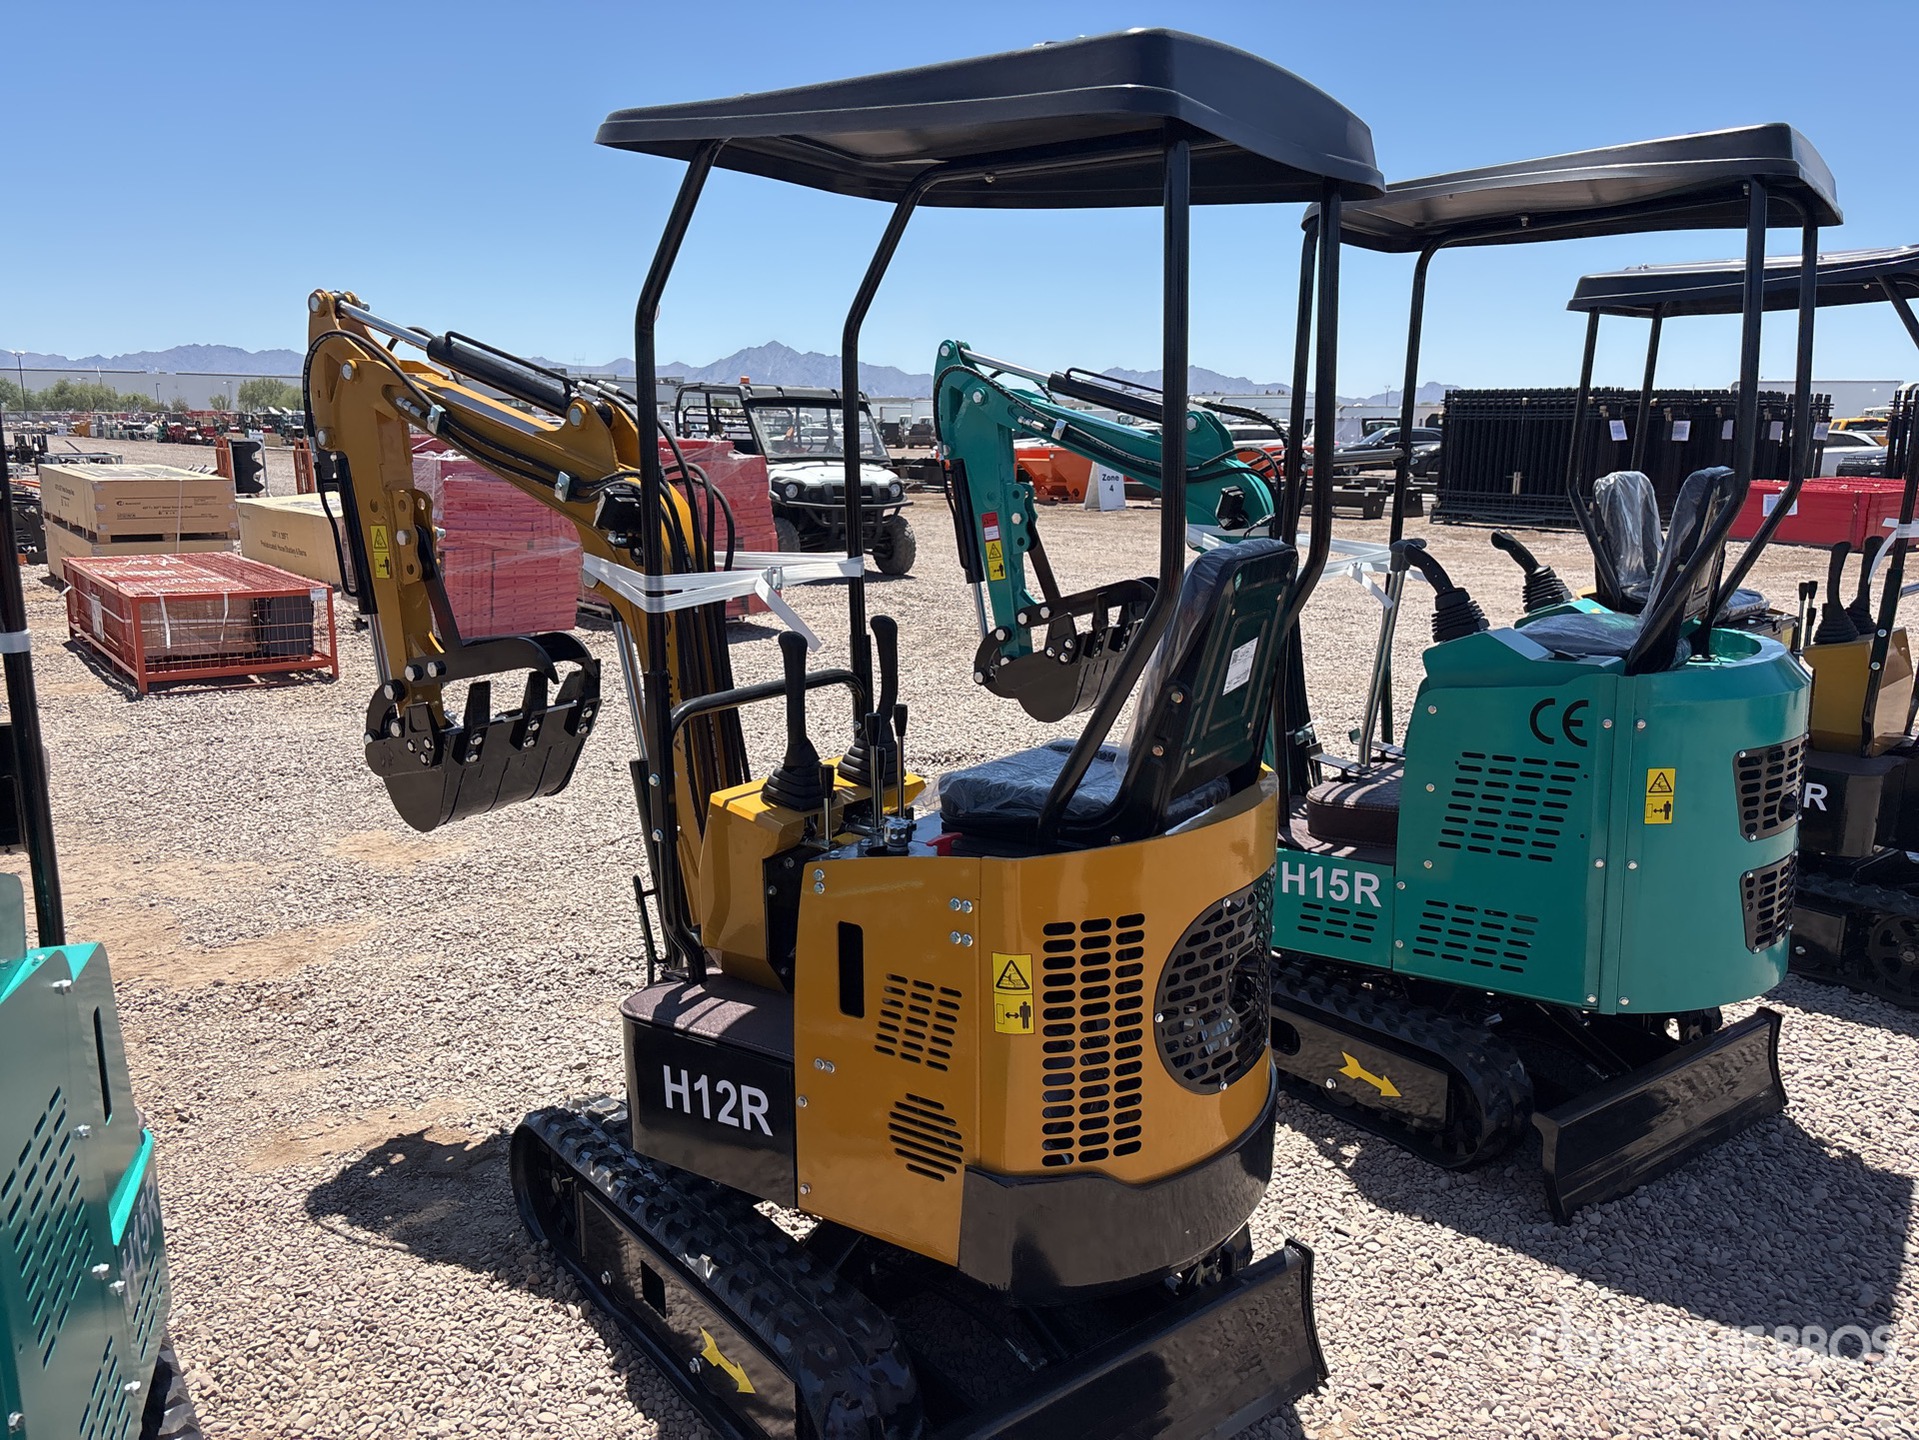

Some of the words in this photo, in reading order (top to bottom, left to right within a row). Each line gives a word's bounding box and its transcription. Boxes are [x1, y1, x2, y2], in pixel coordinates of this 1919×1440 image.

[1102, 473, 1120, 482] Zone
[1109, 484, 1115, 492] 4
[1529, 697, 1589, 748] CE
[1281, 861, 1382, 908] H15R
[663, 1064, 774, 1137] H12R
